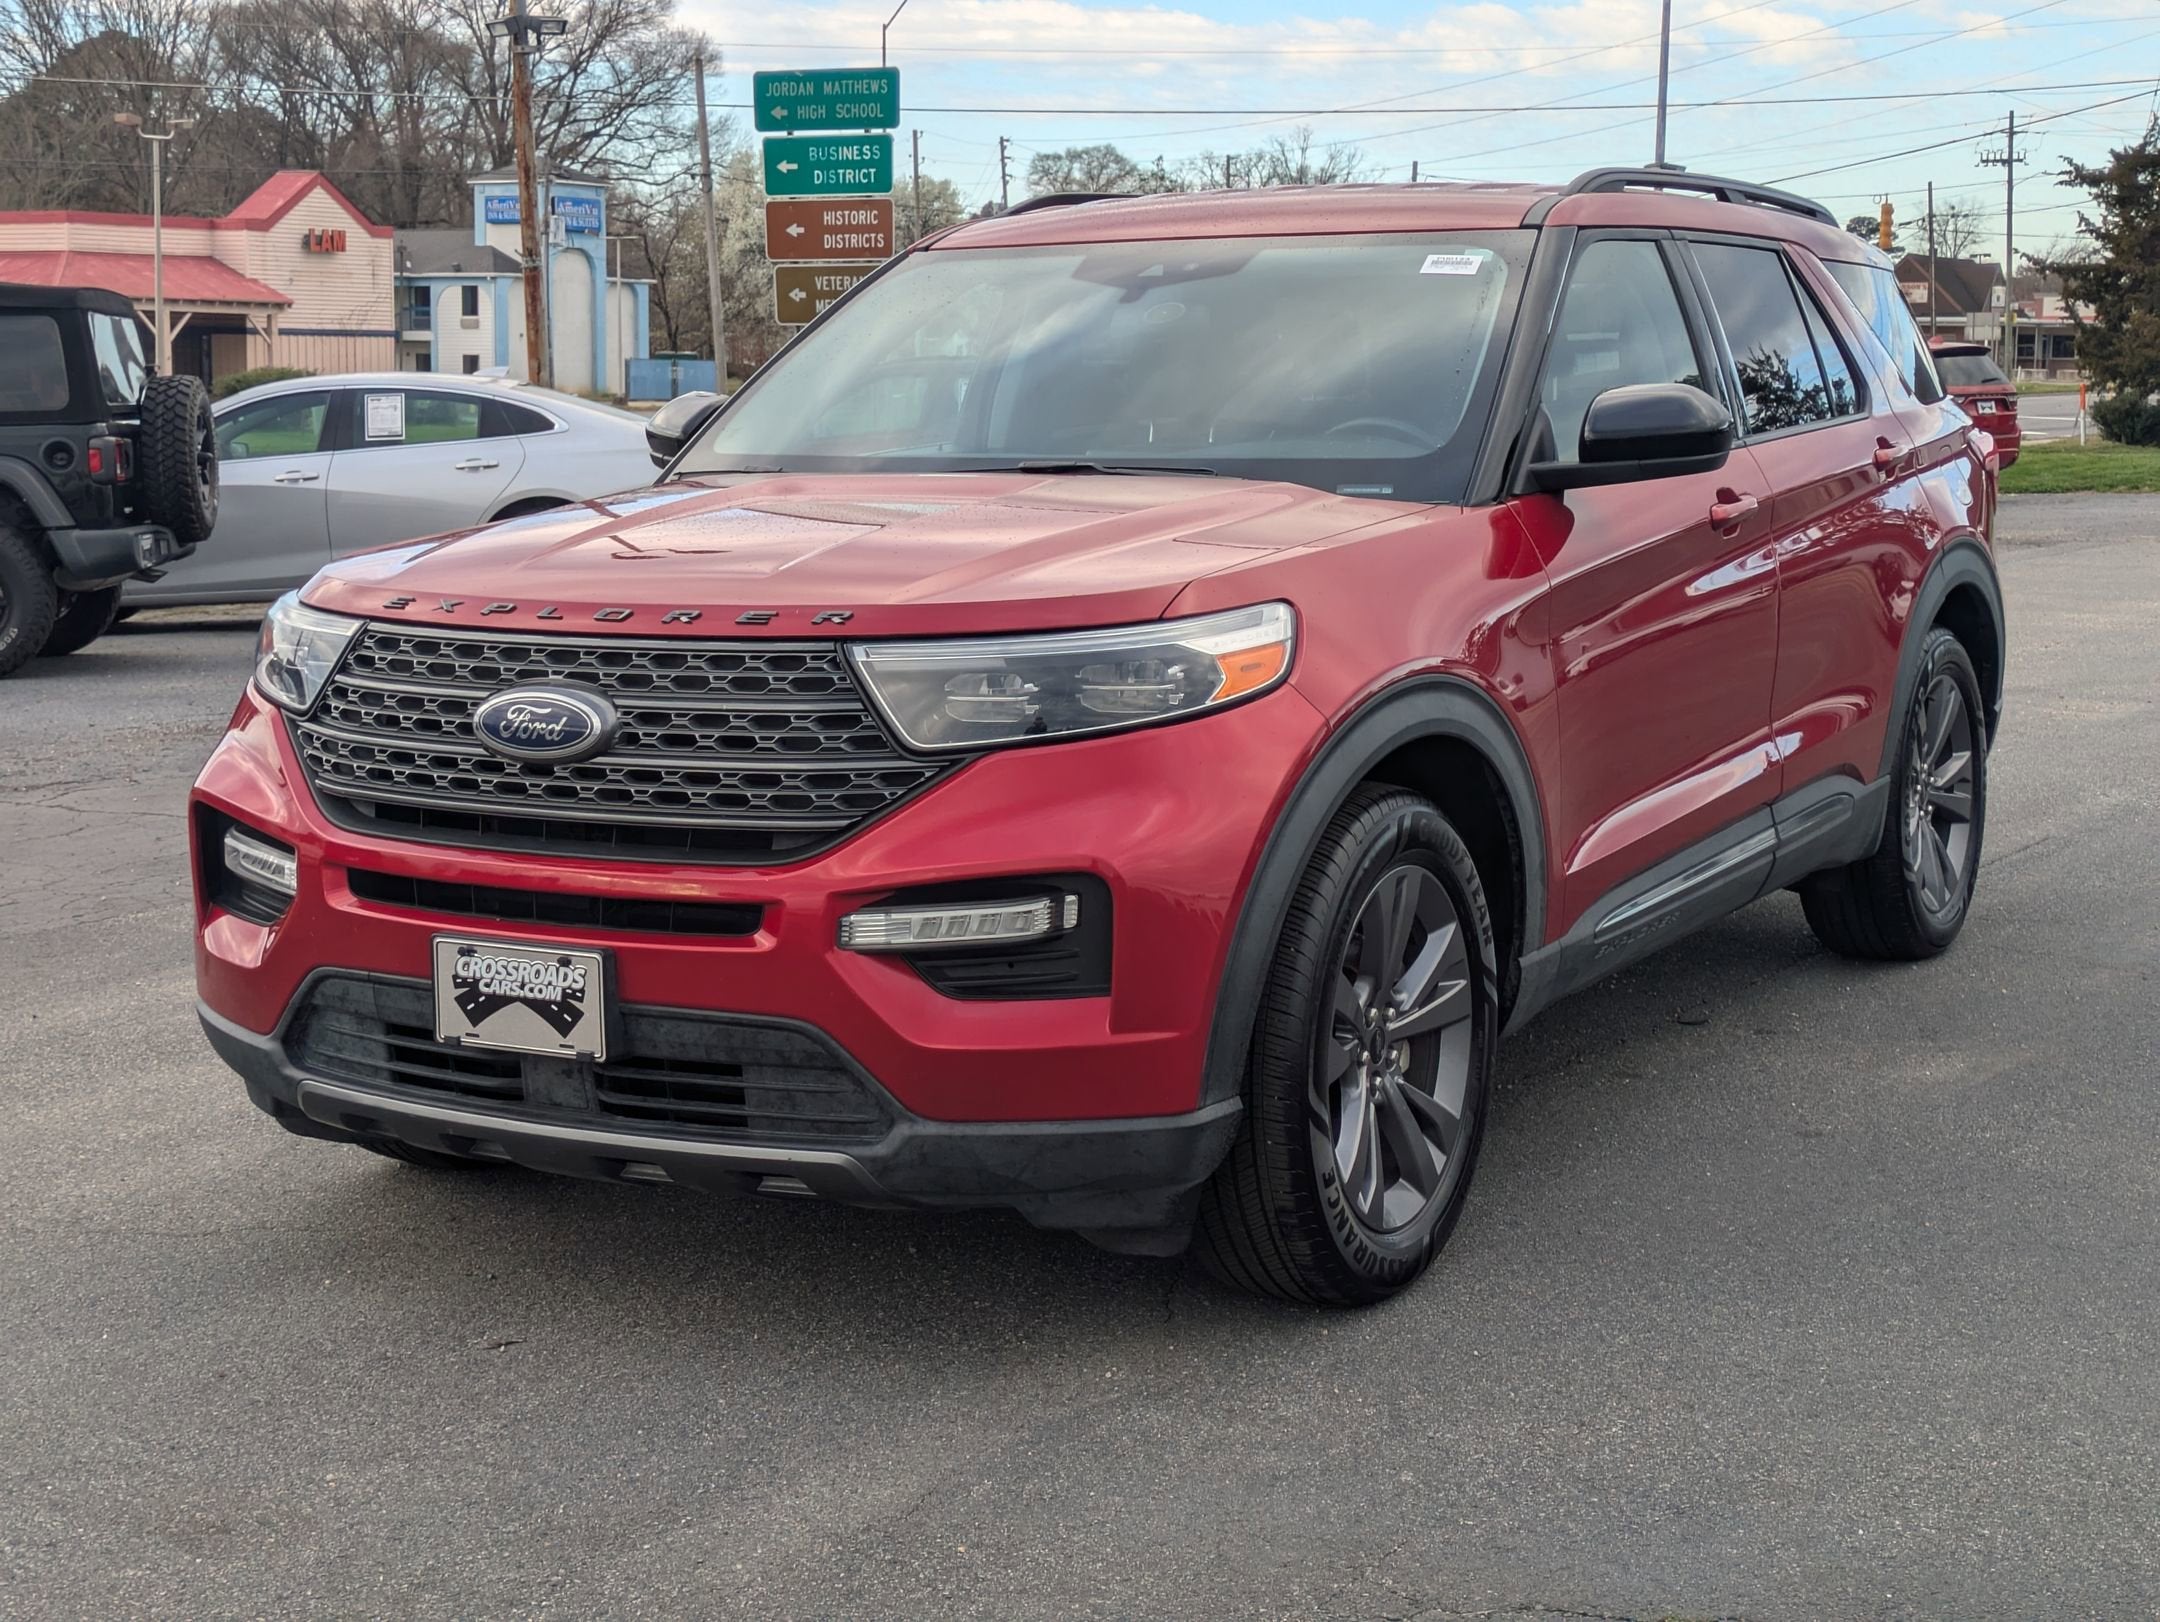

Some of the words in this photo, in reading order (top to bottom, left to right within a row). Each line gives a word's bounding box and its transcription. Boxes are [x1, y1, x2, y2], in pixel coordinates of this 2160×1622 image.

[765, 81, 814, 97] JORDAN
[823, 79, 888, 95] MATTHEWS
[797, 104, 826, 120] HIGH
[836, 103, 884, 119] SCHOOL
[809, 145, 881, 161] BUSINESS
[814, 168, 876, 184] DISTRICT
[823, 210, 879, 225] HISTORIC
[823, 233, 885, 249] DISTRICTS
[814, 275, 865, 290] VETERA
[382, 596, 854, 624] EXPLORER
[500, 704, 568, 741] Ford
[455, 955, 587, 991] CROSSROADS
[478, 978, 563, 1003] CARS.COM
